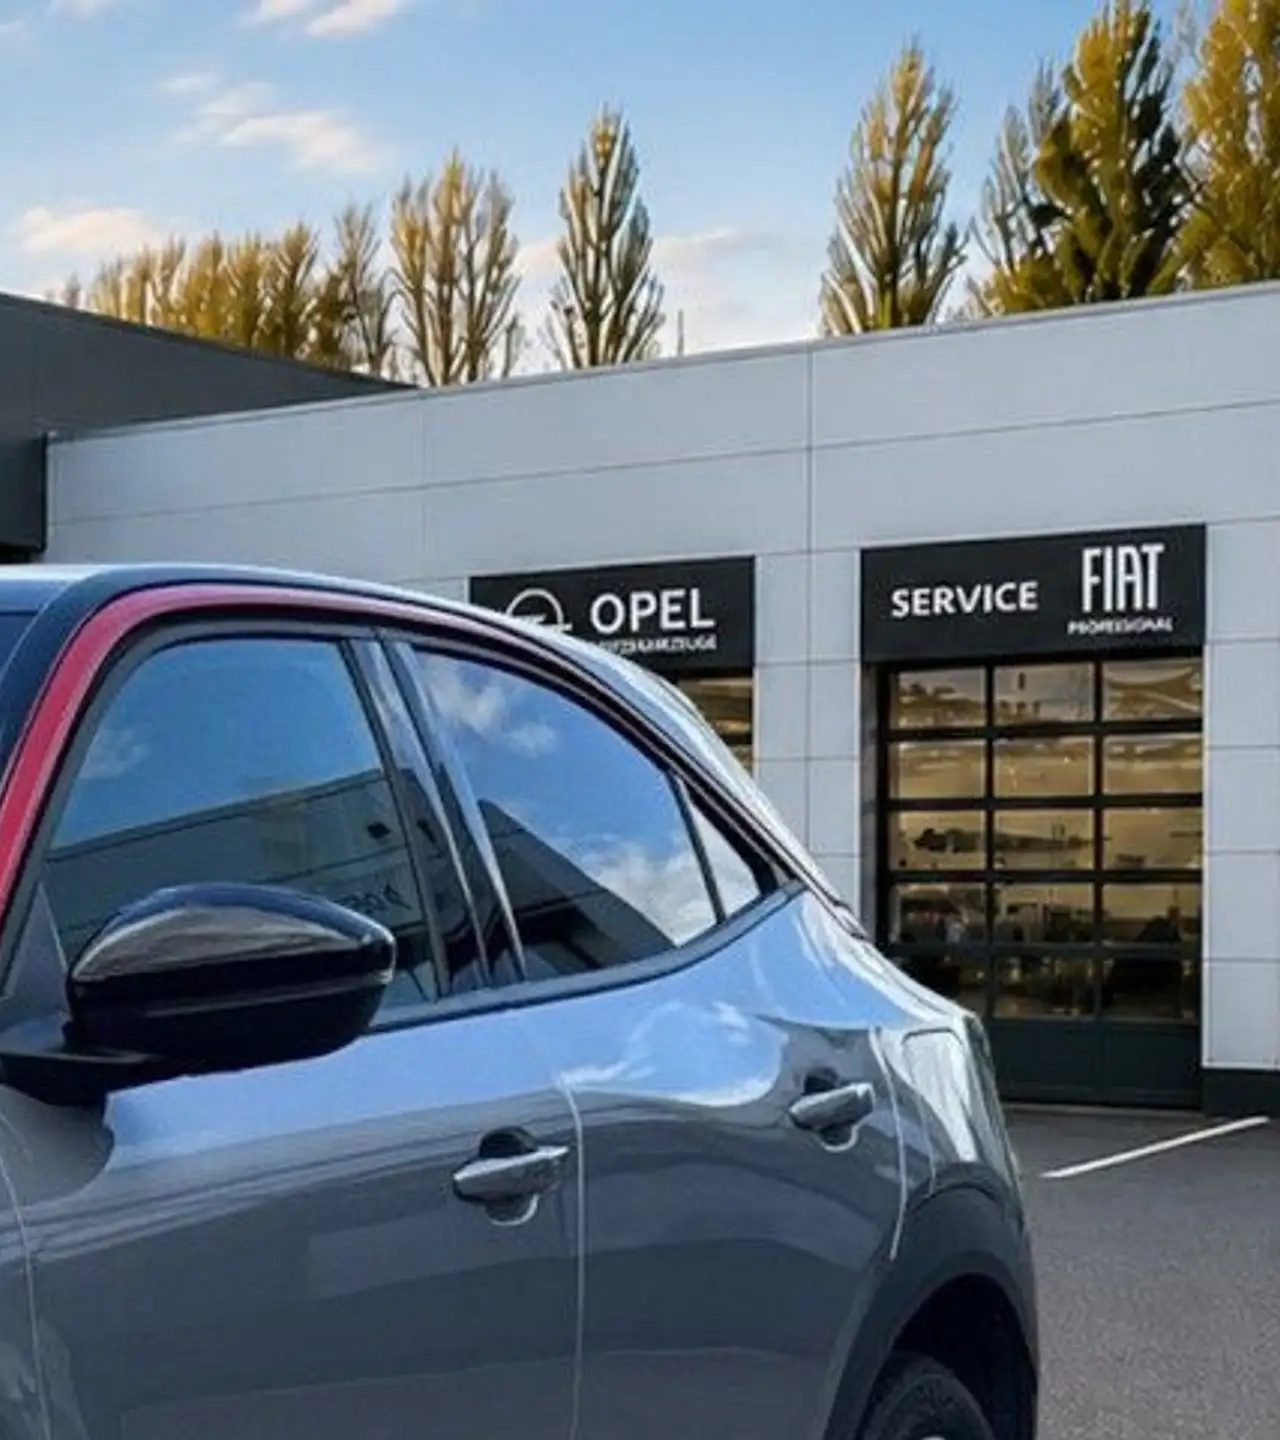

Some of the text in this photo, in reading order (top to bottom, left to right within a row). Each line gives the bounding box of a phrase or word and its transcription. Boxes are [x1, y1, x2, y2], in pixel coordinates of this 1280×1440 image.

[590, 587, 716, 634] OPEL
[890, 542, 1166, 619] SERVICE FIAT
